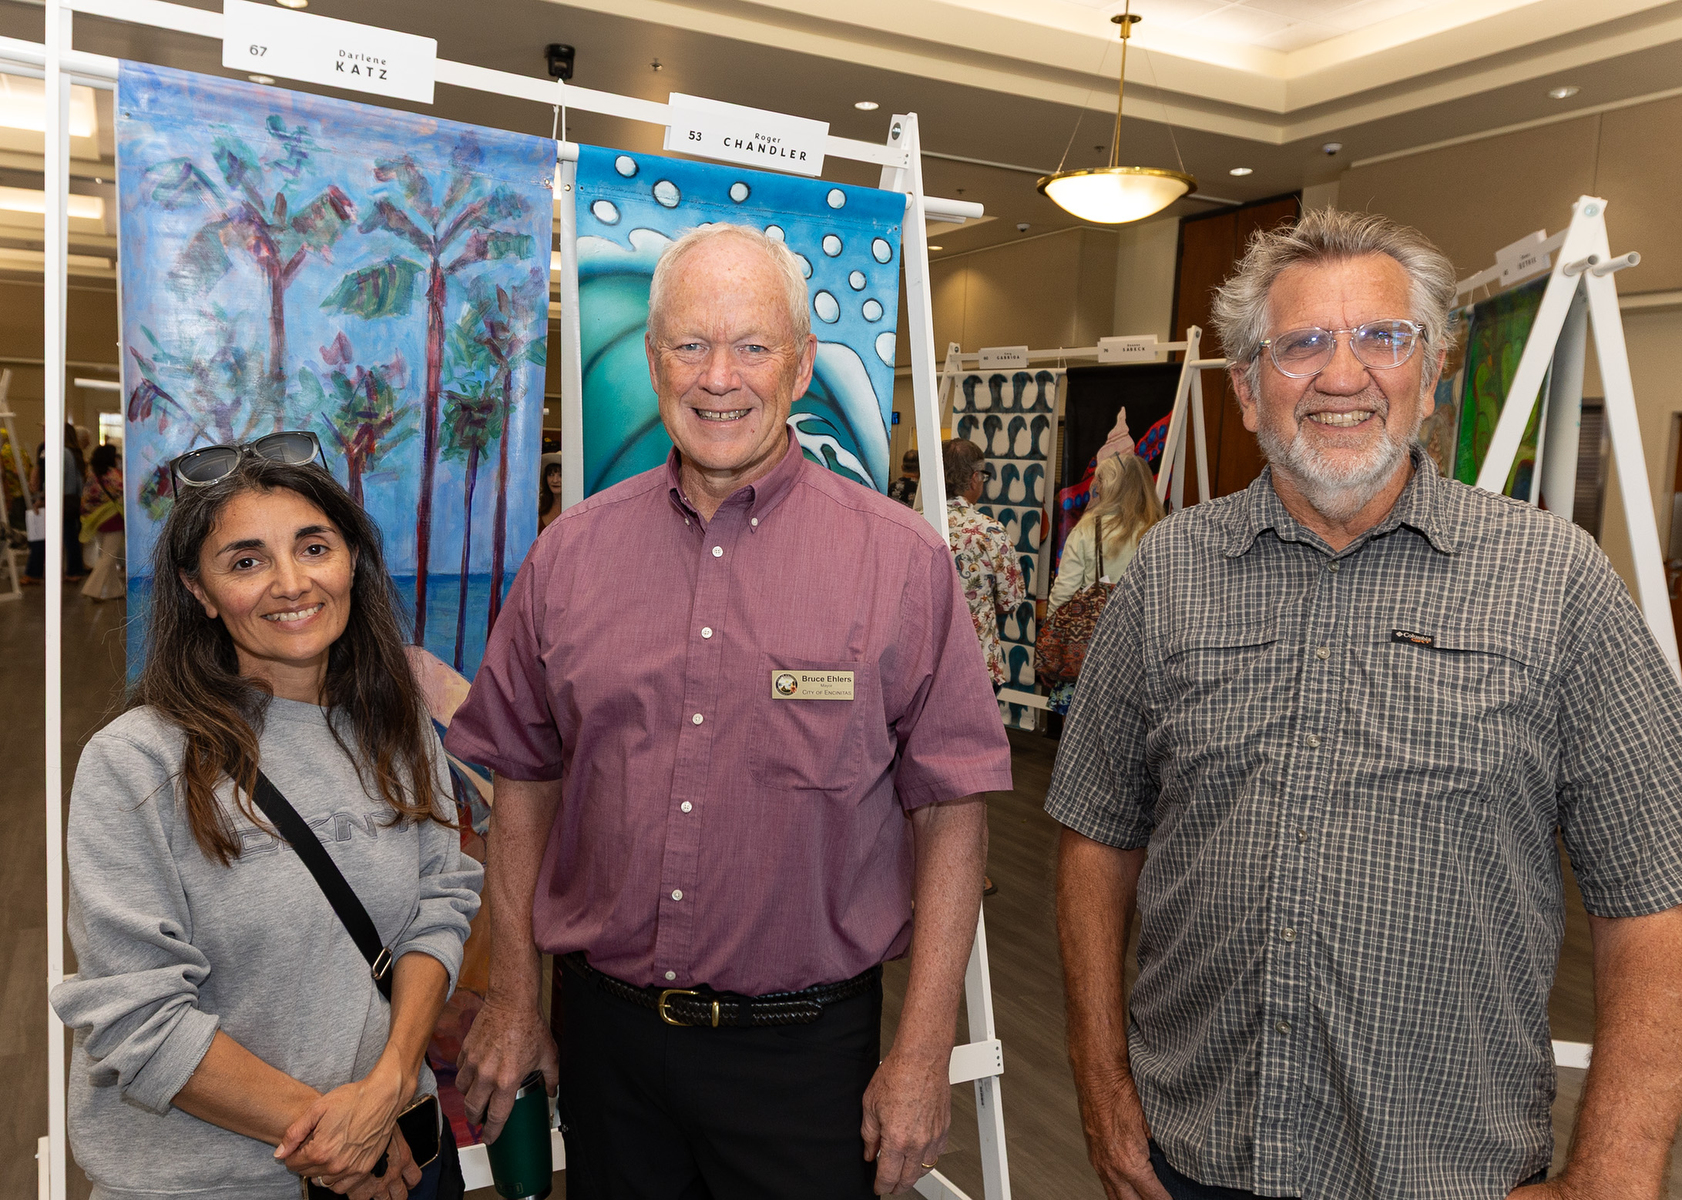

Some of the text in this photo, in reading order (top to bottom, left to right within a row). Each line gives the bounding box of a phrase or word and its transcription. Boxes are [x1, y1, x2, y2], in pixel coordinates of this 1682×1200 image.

[249, 44, 267, 57] 67
[339, 49, 387, 65] Darlene
[336, 61, 388, 80] KATZ
[688, 130, 702, 141] 53
[755, 133, 781, 143] Roger
[723, 137, 807, 161] CHANDLER
[230, 810, 410, 860] DN
